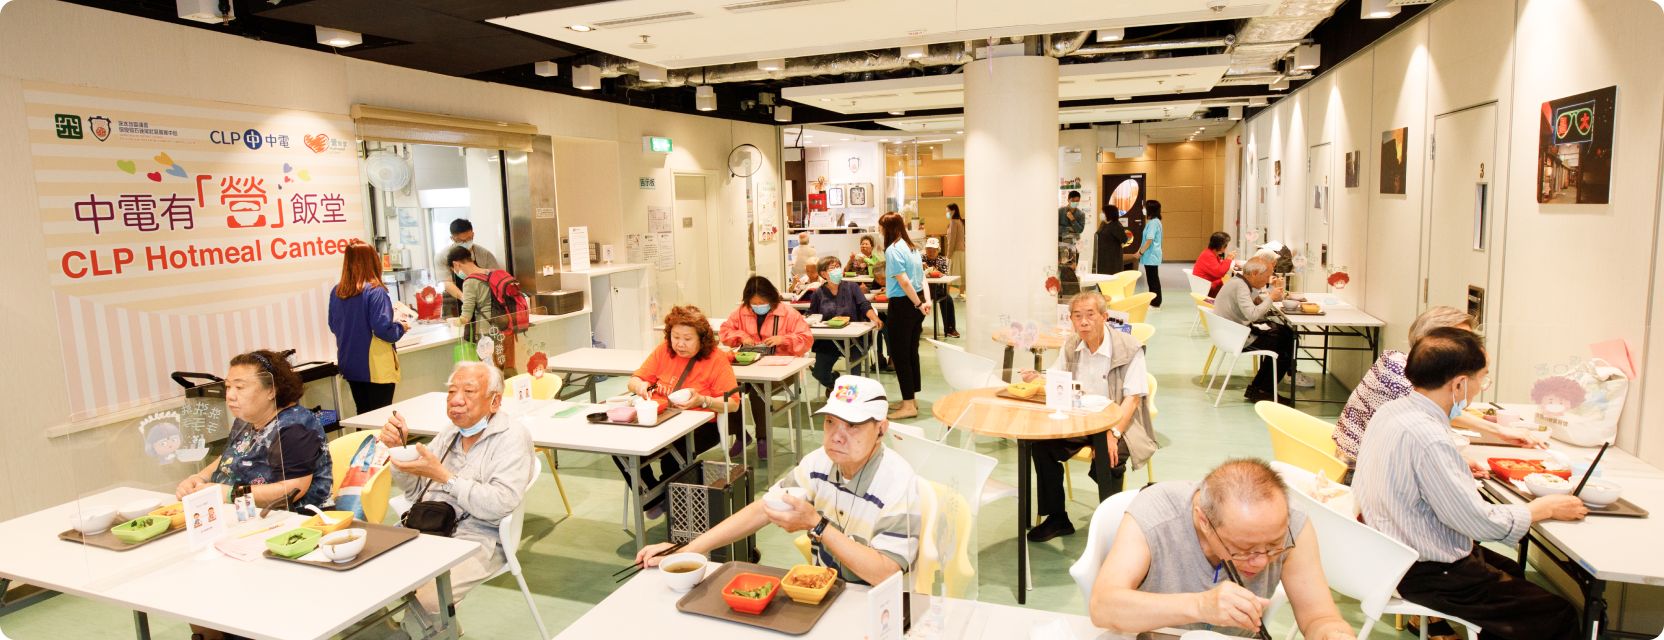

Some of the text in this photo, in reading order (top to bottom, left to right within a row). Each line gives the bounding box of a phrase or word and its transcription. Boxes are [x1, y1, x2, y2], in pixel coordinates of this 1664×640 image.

[1579, 112, 1590, 130] 大
[209, 130, 241, 145] CLP
[265, 133, 290, 149] 中電
[1479, 162, 1485, 179] 3
[61, 248, 134, 279] CLP
[146, 239, 262, 272] Hotmeal
